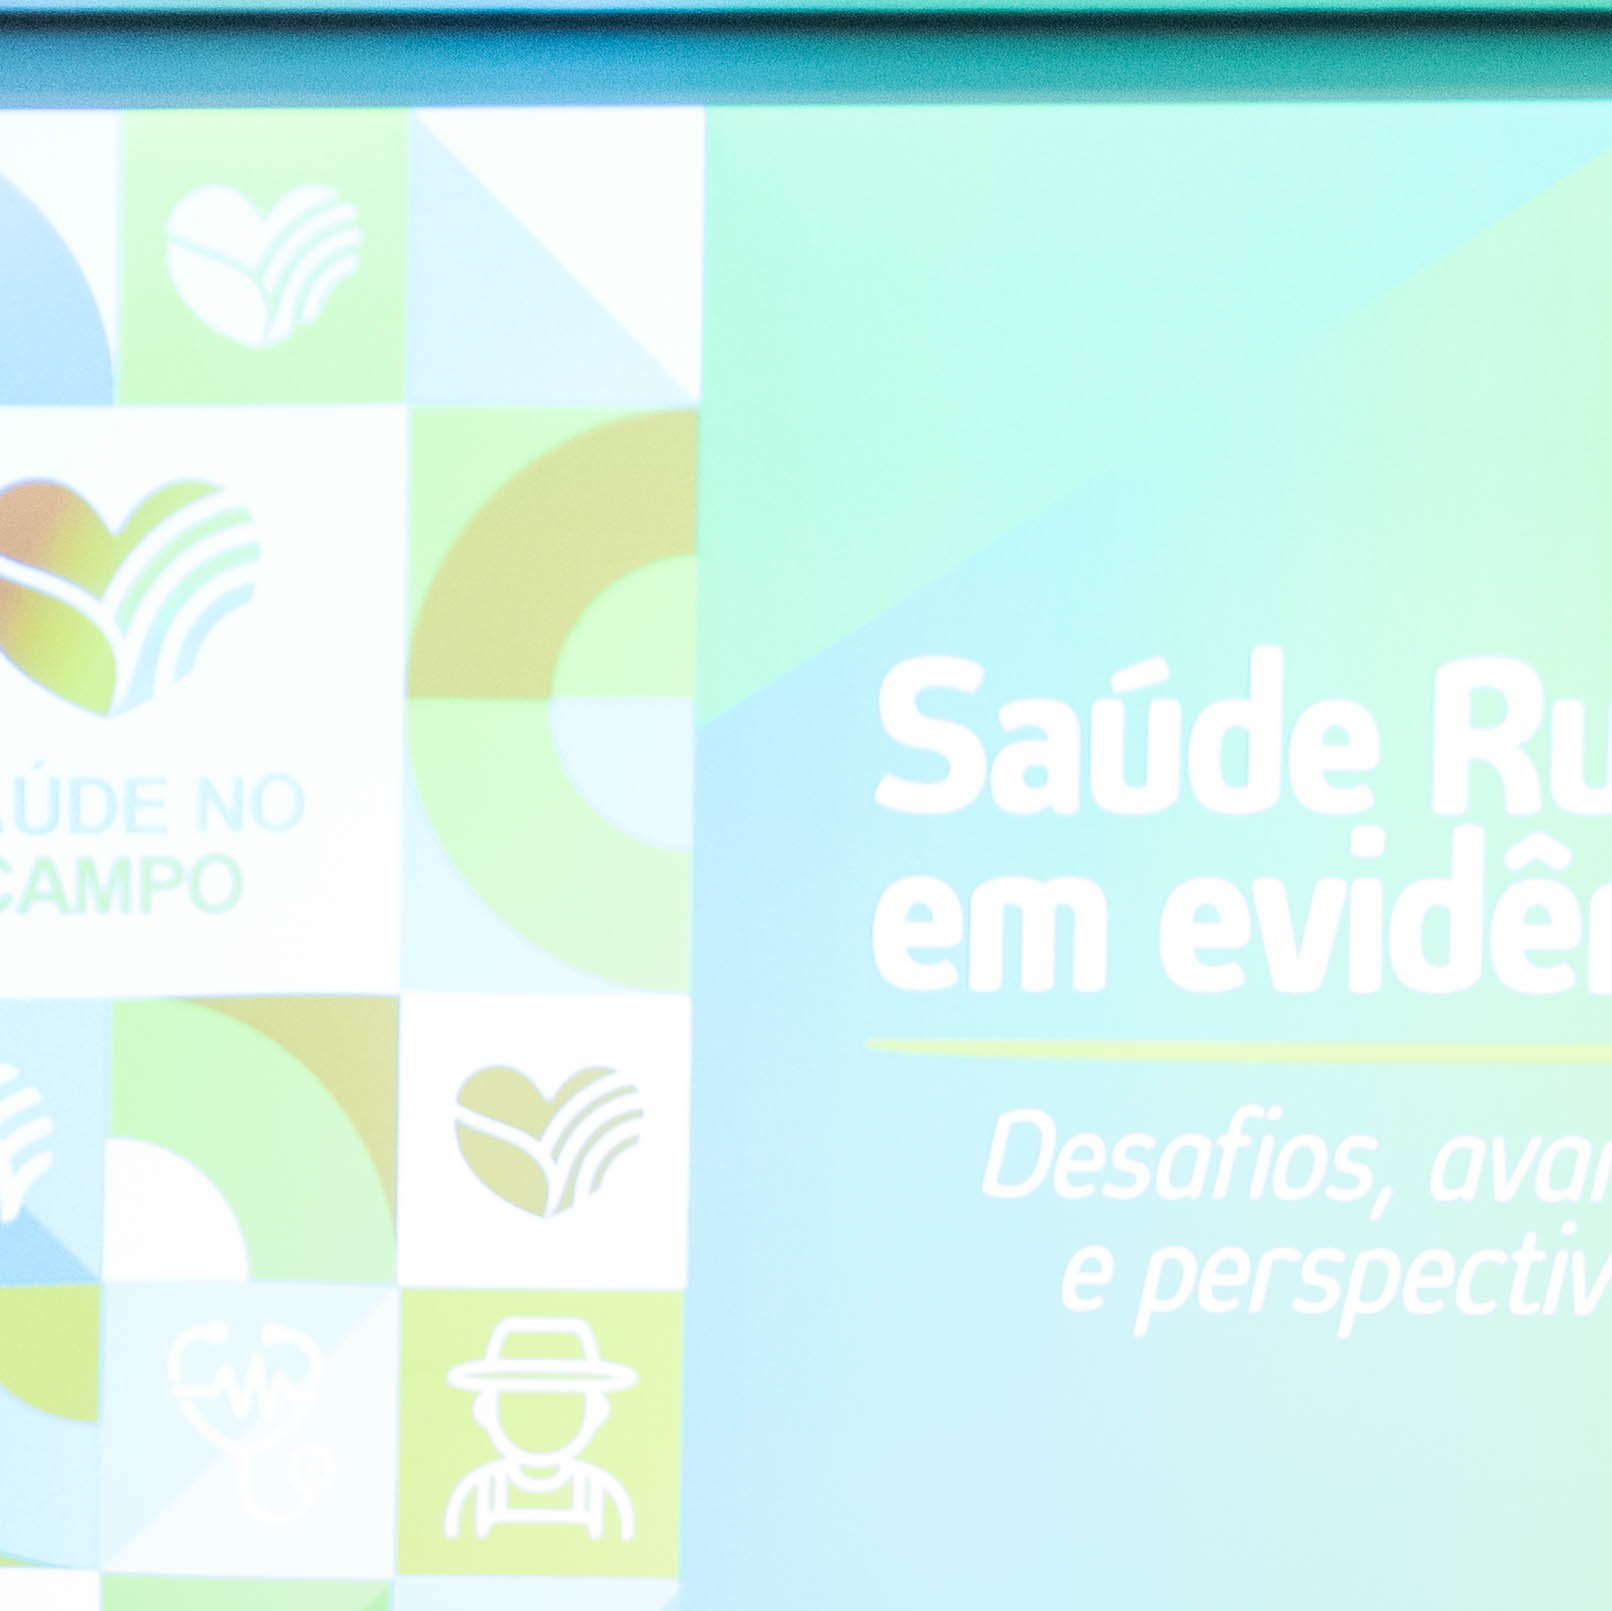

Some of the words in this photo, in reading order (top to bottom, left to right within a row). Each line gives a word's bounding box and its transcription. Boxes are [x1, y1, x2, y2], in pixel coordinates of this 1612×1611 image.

[873, 643, 1383, 817] Saúde
[0, 758, 169, 836] ÚDE
[195, 771, 306, 834] NO
[871, 874, 1109, 994] em
[980, 1103, 1394, 1222] Desafios,
[1060, 1244, 1115, 1313] e
